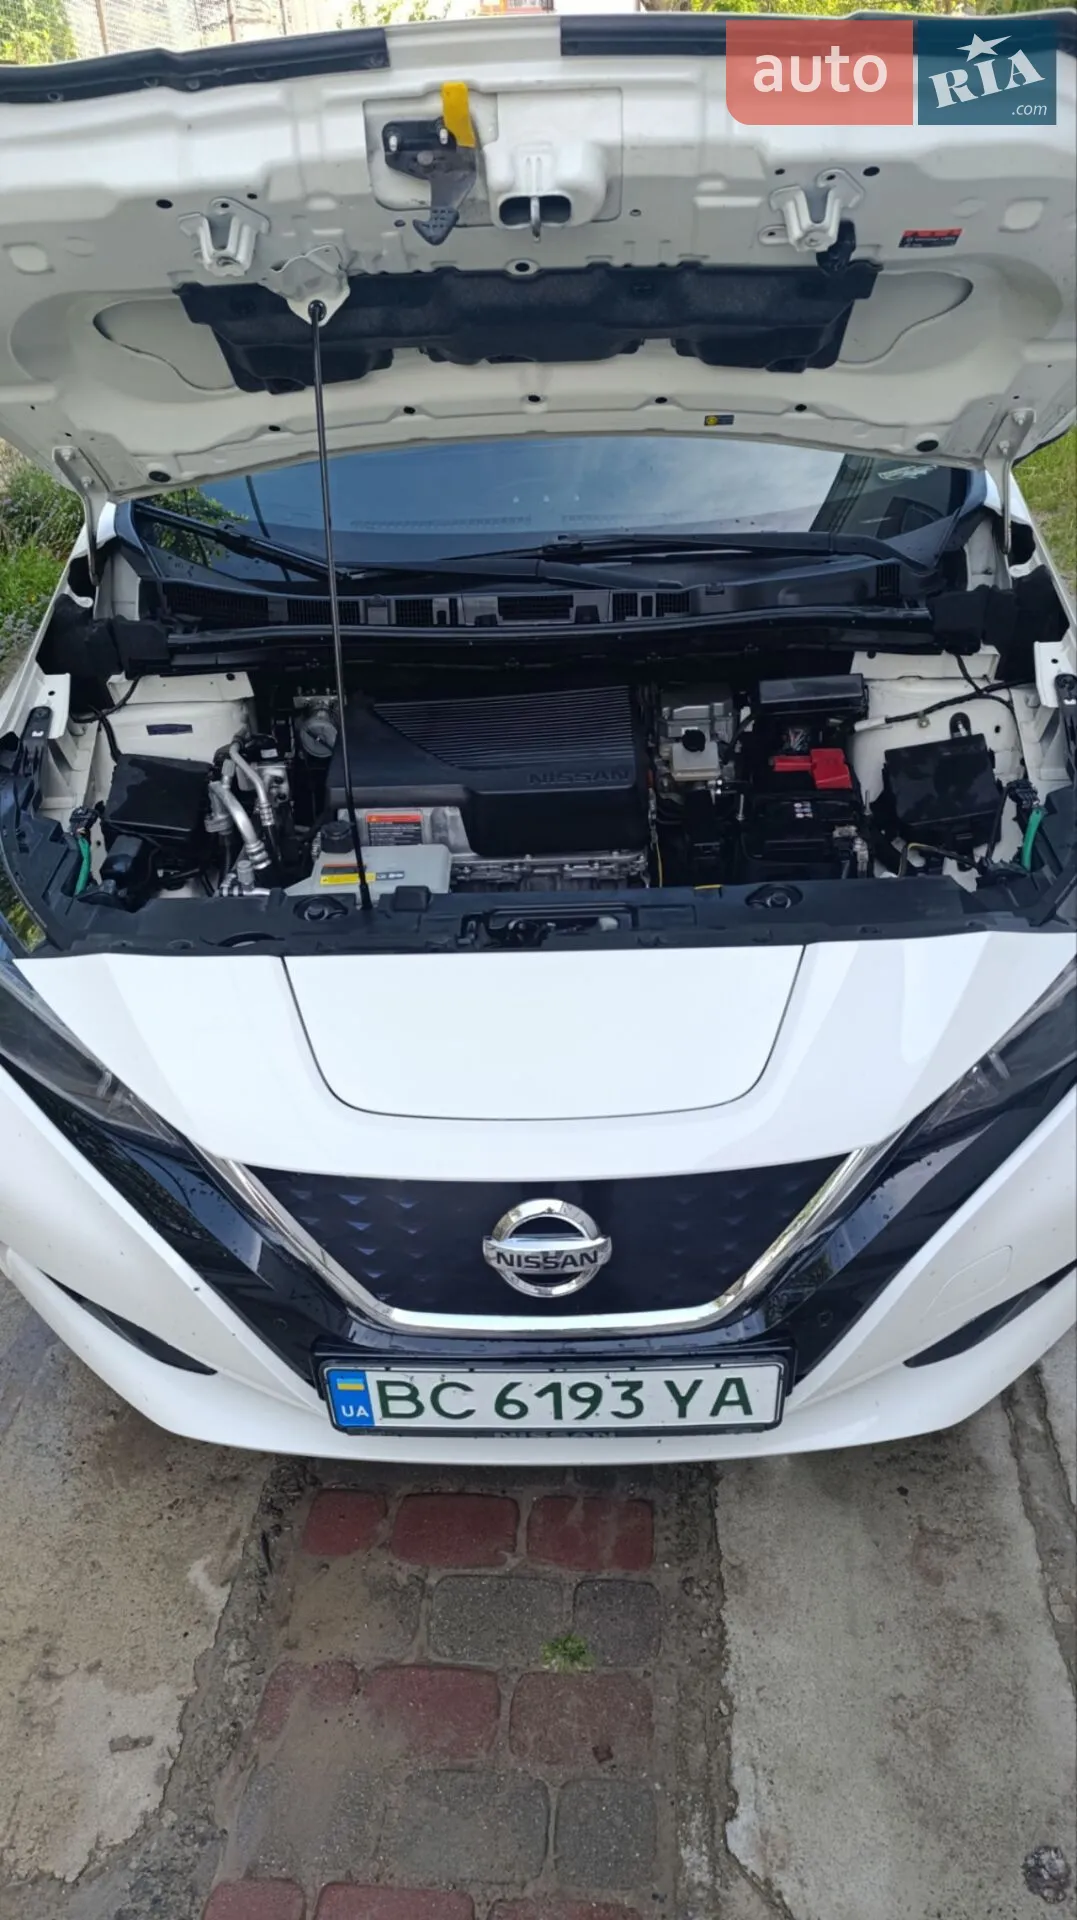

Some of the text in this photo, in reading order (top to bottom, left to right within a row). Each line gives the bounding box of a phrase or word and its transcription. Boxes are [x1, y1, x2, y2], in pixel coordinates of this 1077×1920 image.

[528, 769, 630, 785] NISSAN
[496, 1250, 598, 1269] NISSAN
[376, 1377, 753, 1420] BC 6193 YA
[341, 1405, 369, 1417] UA
